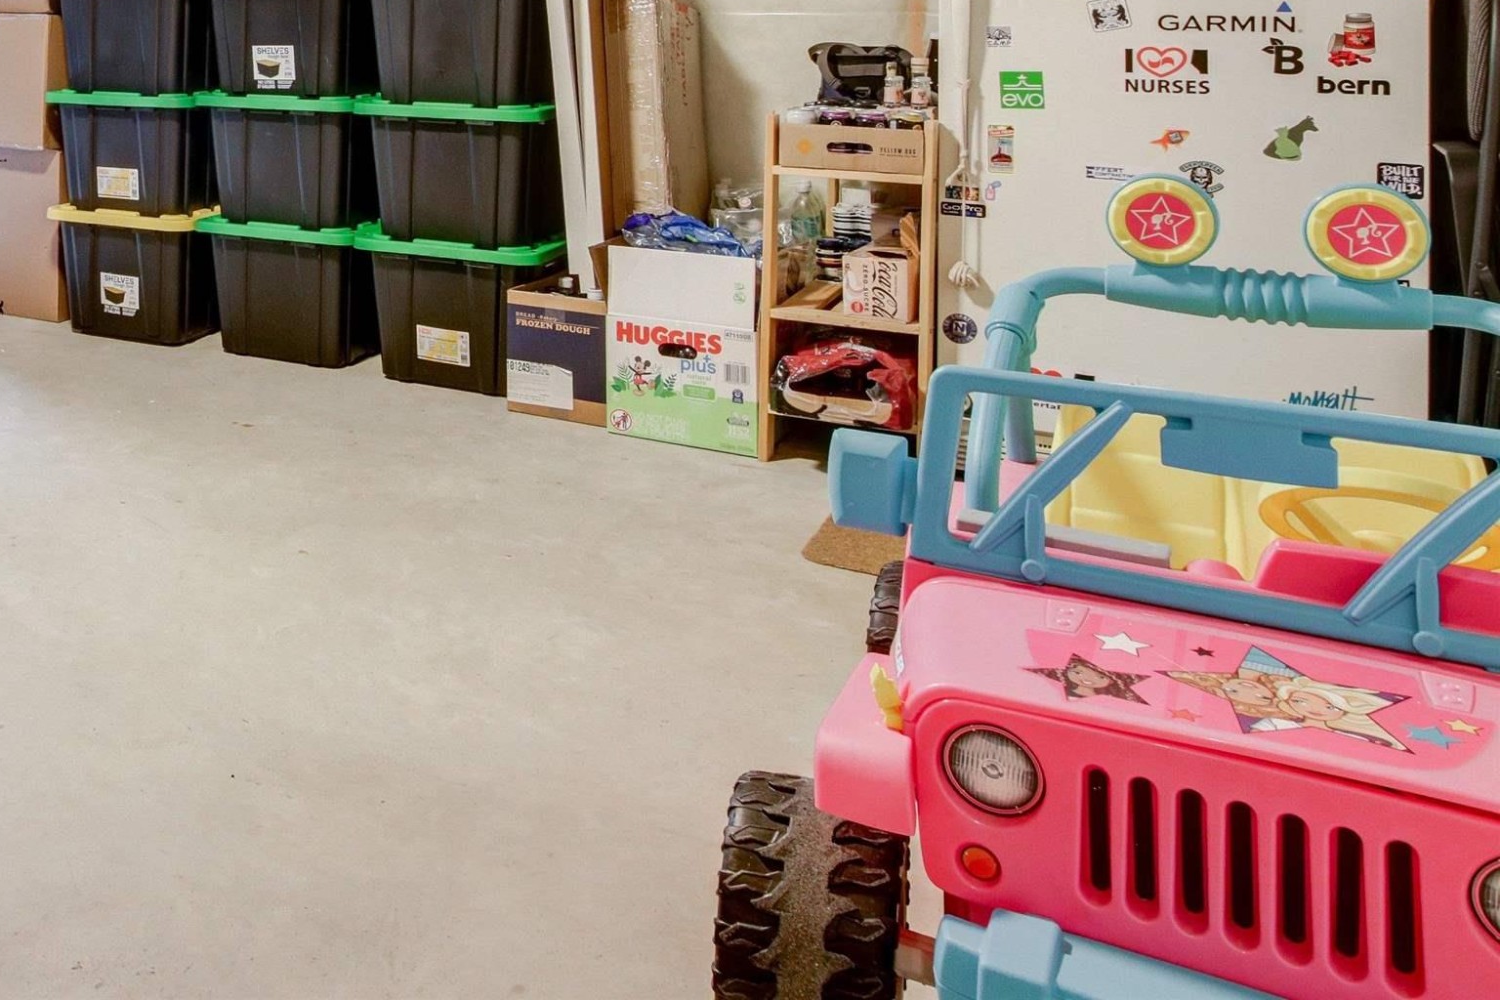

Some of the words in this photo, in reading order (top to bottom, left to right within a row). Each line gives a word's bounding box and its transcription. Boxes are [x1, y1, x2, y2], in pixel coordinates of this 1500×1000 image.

[1158, 14, 1296, 33] GARMIN
[1125, 48, 1133, 73] I
[1125, 79, 1210, 94] NURSES
[1317, 76, 1391, 95] bern
[1002, 93, 1043, 107] evo
[1379, 165, 1422, 177] BUILT
[942, 203, 983, 213] GoPro
[515, 318, 553, 331] FROZEN
[555, 323, 591, 335] DOUGH
[616, 321, 723, 354] HUGGIES
[680, 356, 717, 375] plus
